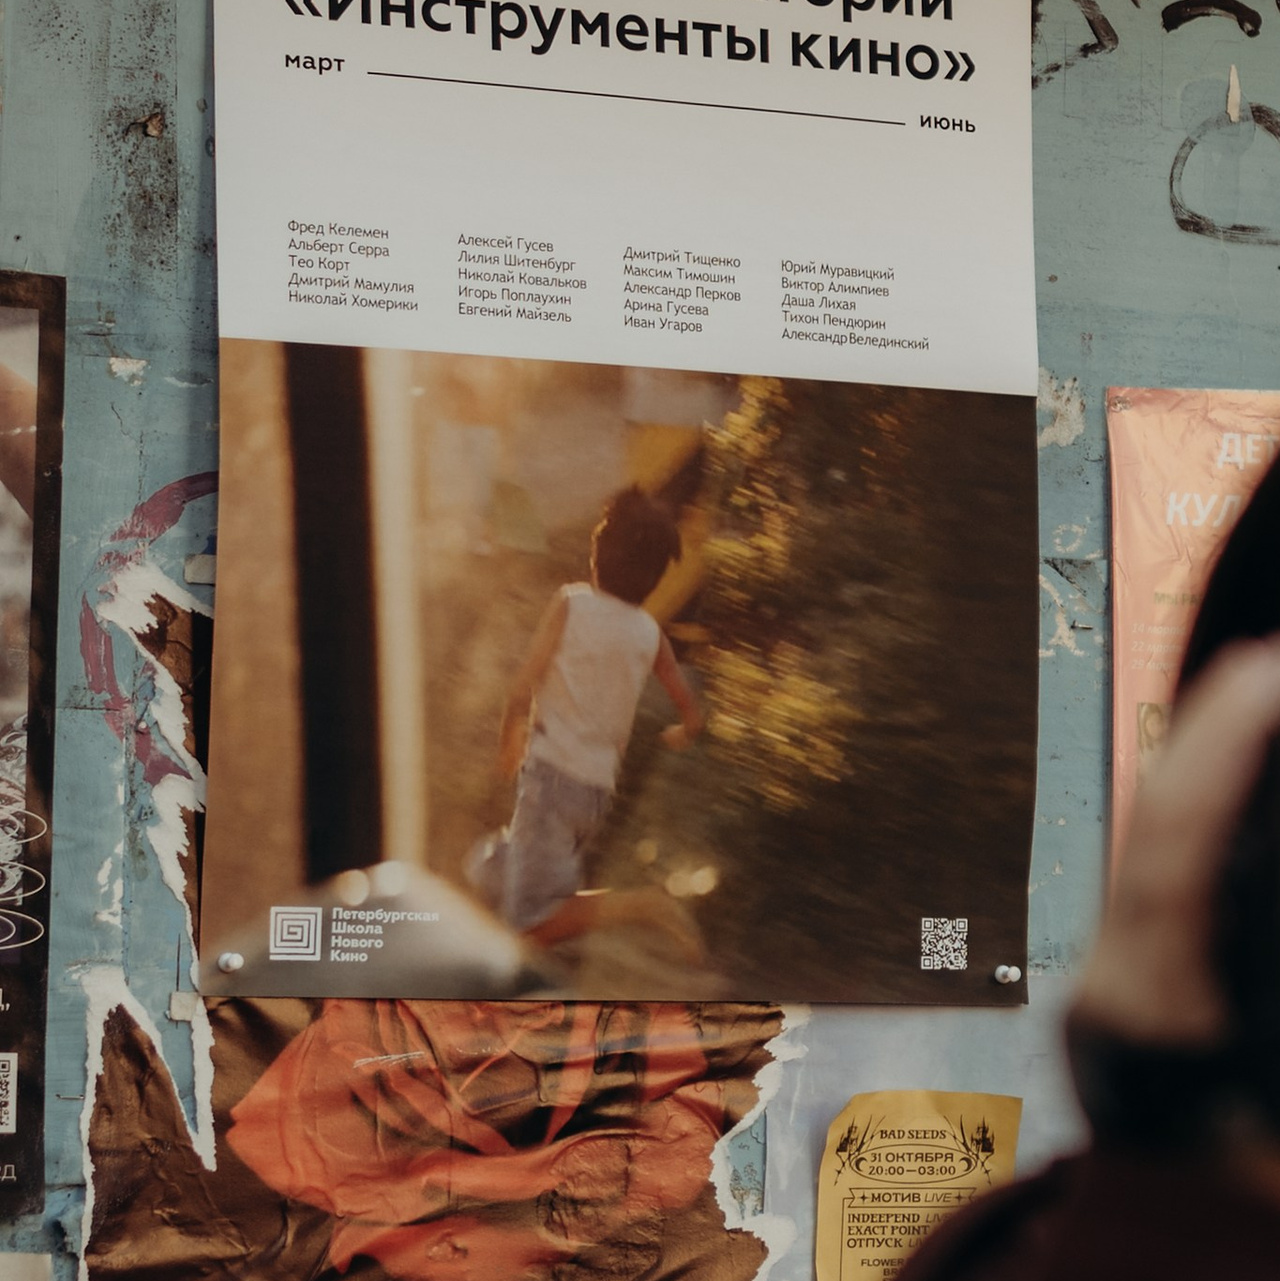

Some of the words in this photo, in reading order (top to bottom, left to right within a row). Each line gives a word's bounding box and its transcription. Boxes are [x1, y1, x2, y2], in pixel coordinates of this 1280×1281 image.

[284, 53, 345, 75] март
[790, 28, 976, 84] кино»
[920, 114, 976, 133] июнь
[288, 220, 324, 236] Фред
[329, 223, 389, 239] Келемен
[288, 238, 344, 254] Альберт
[349, 242, 390, 257] Серра
[458, 234, 513, 250] Алексей
[517, 238, 554, 253] Гусев
[288, 255, 315, 269] Тео
[318, 257, 350, 272] Корт
[458, 251, 500, 265] Лилия
[504, 254, 577, 272] Шитенбург
[623, 247, 680, 263] Дмитрий
[684, 251, 741, 268] Тищенко
[458, 268, 515, 284] Николай
[518, 273, 587, 290] Ковальков
[623, 264, 672, 279] Максим
[676, 268, 736, 284] Тимошин
[781, 260, 816, 275] Юрий
[820, 263, 895, 281] Муравицкий
[288, 273, 349, 289] Дмитрий
[354, 279, 415, 293] Мамулия
[623, 281, 692, 299] Александр
[696, 287, 741, 302] Перков
[781, 277, 825, 293] Виктор
[828, 281, 890, 297] Алимпиев
[288, 290, 347, 306] Николай
[351, 296, 418, 312] Хомерики
[458, 285, 497, 302] Игорь
[501, 289, 572, 306] Поплаухин
[781, 294, 815, 310] Даша
[818, 296, 856, 311] Лихая
[458, 302, 512, 319] Евгений
[516, 307, 572, 323] Майзель
[624, 298, 663, 313] Арина
[666, 301, 709, 316] Гусева
[624, 315, 656, 329] Иван
[659, 318, 703, 334] Угаров
[782, 310, 819, 325] Тихон
[823, 314, 886, 331] Пендюрин
[332, 906, 440, 924] Петербургская
[331, 921, 383, 935] Школа
[330, 935, 384, 949] Нового
[330, 949, 368, 962] Кино
[879, 1129, 906, 1140] BAD
[907, 1129, 948, 1140] SEEDS
[870, 1152, 882, 1163] 31
[885, 1151, 954, 1163] ОКТЯБРЯ
[870, 1192, 921, 1203] МОТИВ
[924, 1192, 953, 1203] LIVE
[847, 1225, 887, 1236] EXACT
[891, 1225, 930, 1236] POINT
[847, 1237, 903, 1248] ОТПУСК
